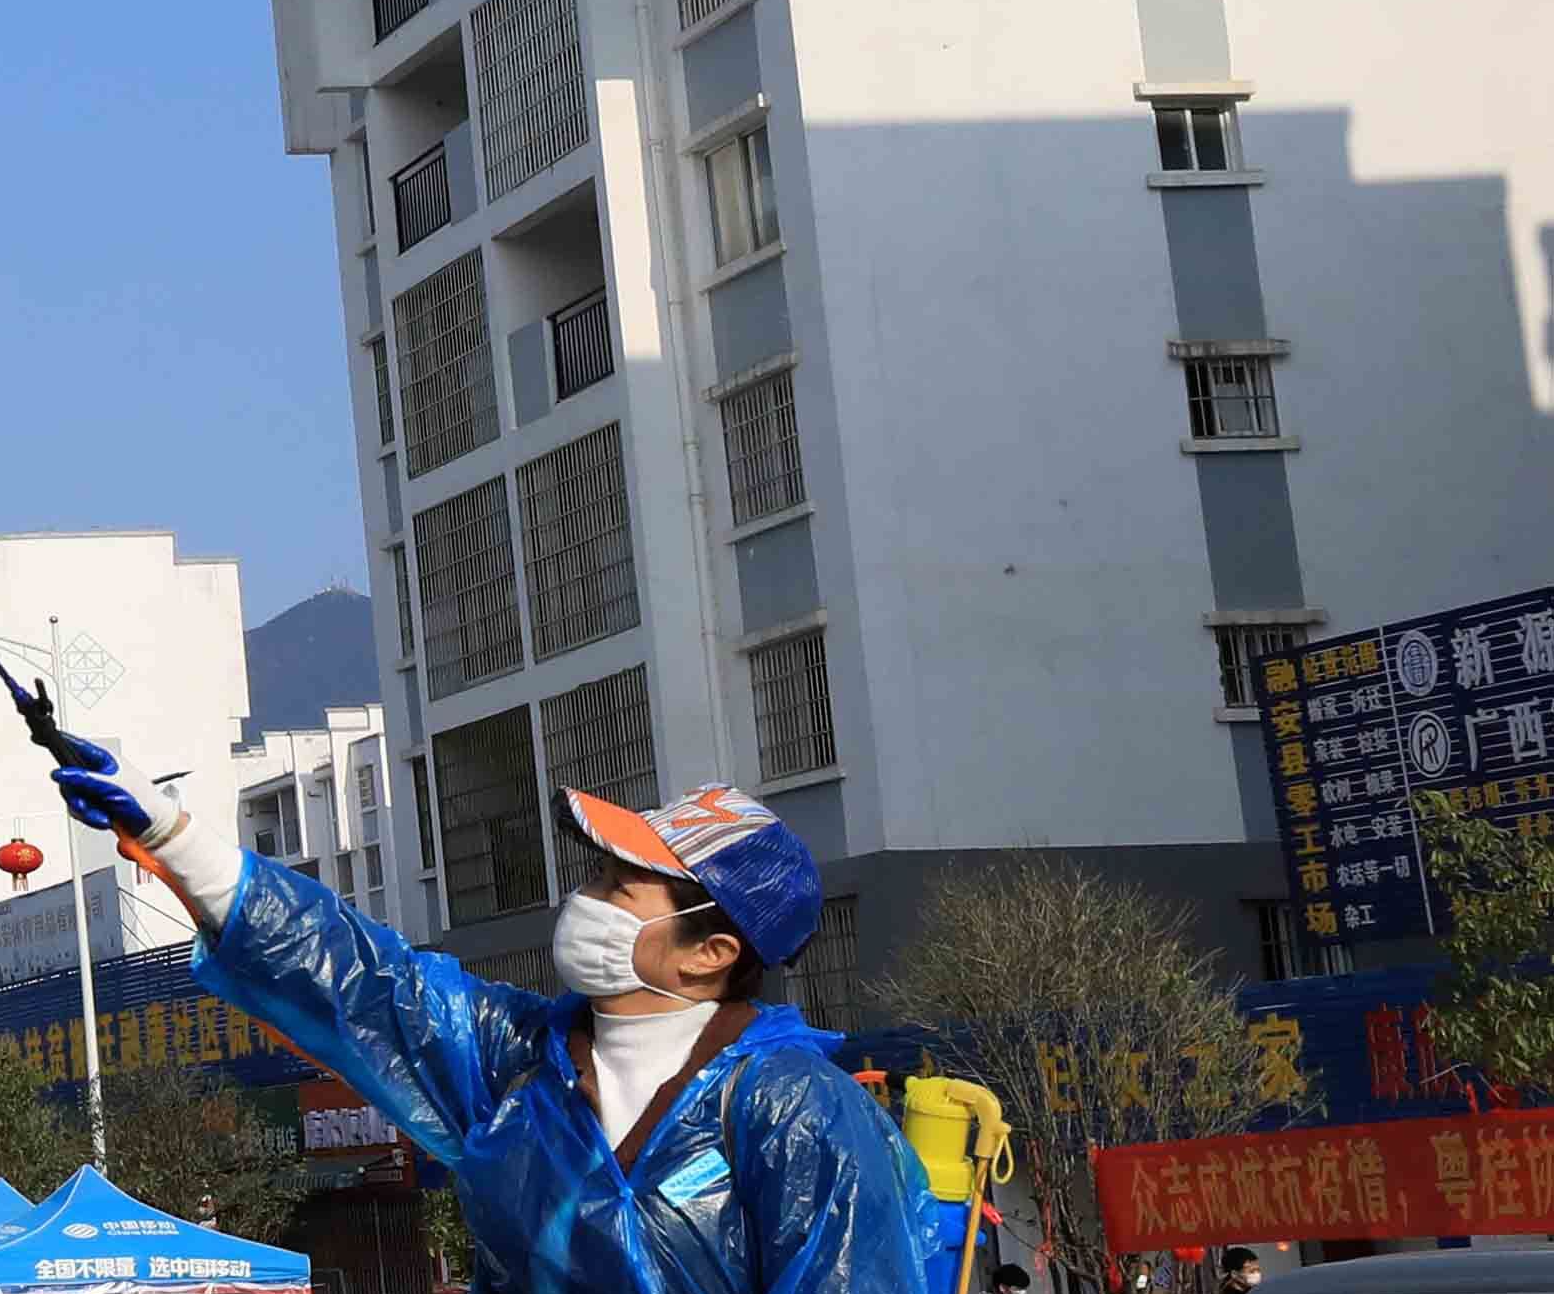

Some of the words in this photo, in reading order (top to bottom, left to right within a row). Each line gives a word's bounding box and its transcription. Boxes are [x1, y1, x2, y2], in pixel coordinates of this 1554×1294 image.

[1465, 697, 1554, 772] 广西
[34, 1256, 137, 1279] 全国不限量
[148, 1255, 251, 1279] 选中国移动
